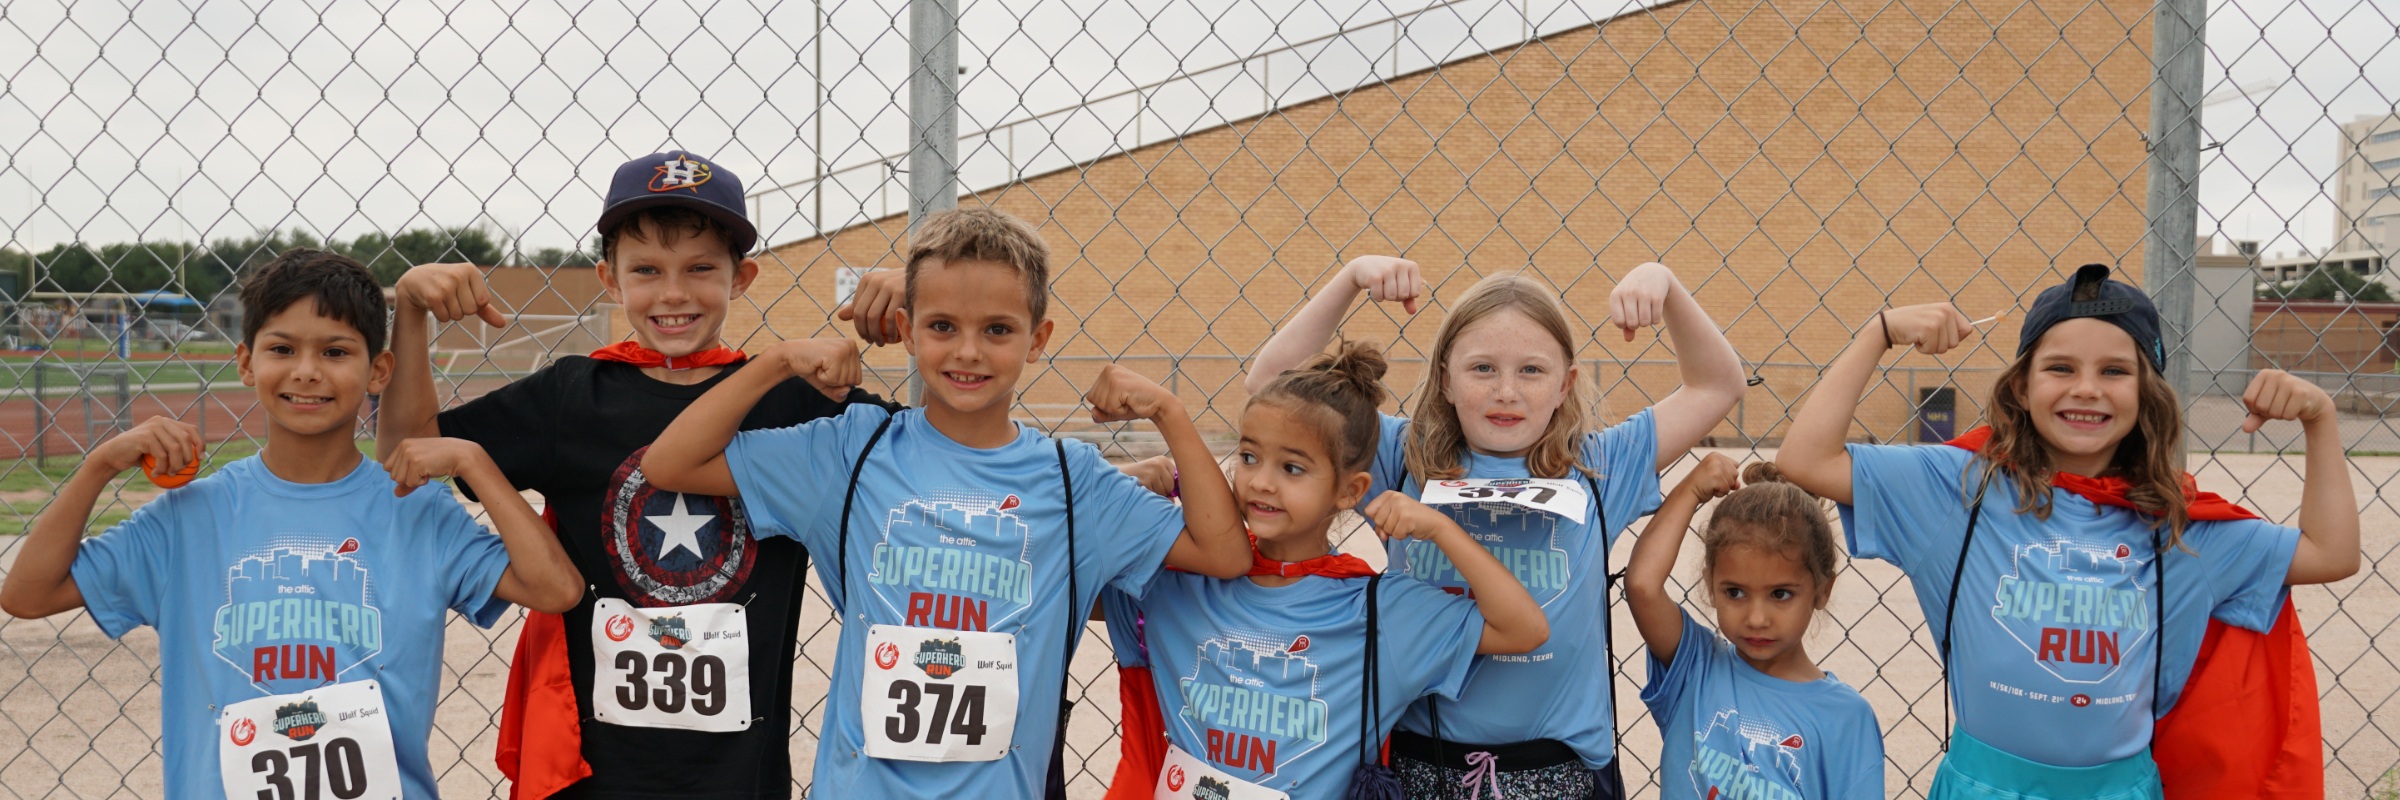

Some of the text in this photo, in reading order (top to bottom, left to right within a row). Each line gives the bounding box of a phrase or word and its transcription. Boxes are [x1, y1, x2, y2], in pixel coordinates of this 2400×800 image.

[662, 160, 699, 184] H
[939, 534, 977, 547] the attic
[1469, 532, 1504, 543] the attic
[869, 546, 1031, 605] SUPERHERO
[2066, 575, 2104, 584] the attic
[278, 584, 316, 595] the attic
[906, 592, 988, 632] RUN
[1994, 579, 2147, 631] SUPERHERO
[215, 598, 379, 650] SUPERHERO
[703, 630, 741, 641] Wolf Squid
[2038, 627, 2121, 666] RUN
[254, 644, 336, 683] RUN
[914, 651, 966, 668] SUPERHERO
[977, 660, 1013, 671] Wolf Squid
[1492, 652, 1554, 664] MIDLAND, TEXAS
[926, 663, 953, 676] RUN
[615, 650, 727, 716] 339
[1229, 673, 1265, 688] the attic
[273, 711, 327, 732] SUPERHERO
[339, 706, 379, 721] Wolf Squid
[885, 679, 987, 746] 374
[1181, 680, 1326, 743] SUPERHERO
[288, 724, 316, 739] RUN
[1207, 728, 1277, 775] RUN
[251, 737, 368, 800] 370
